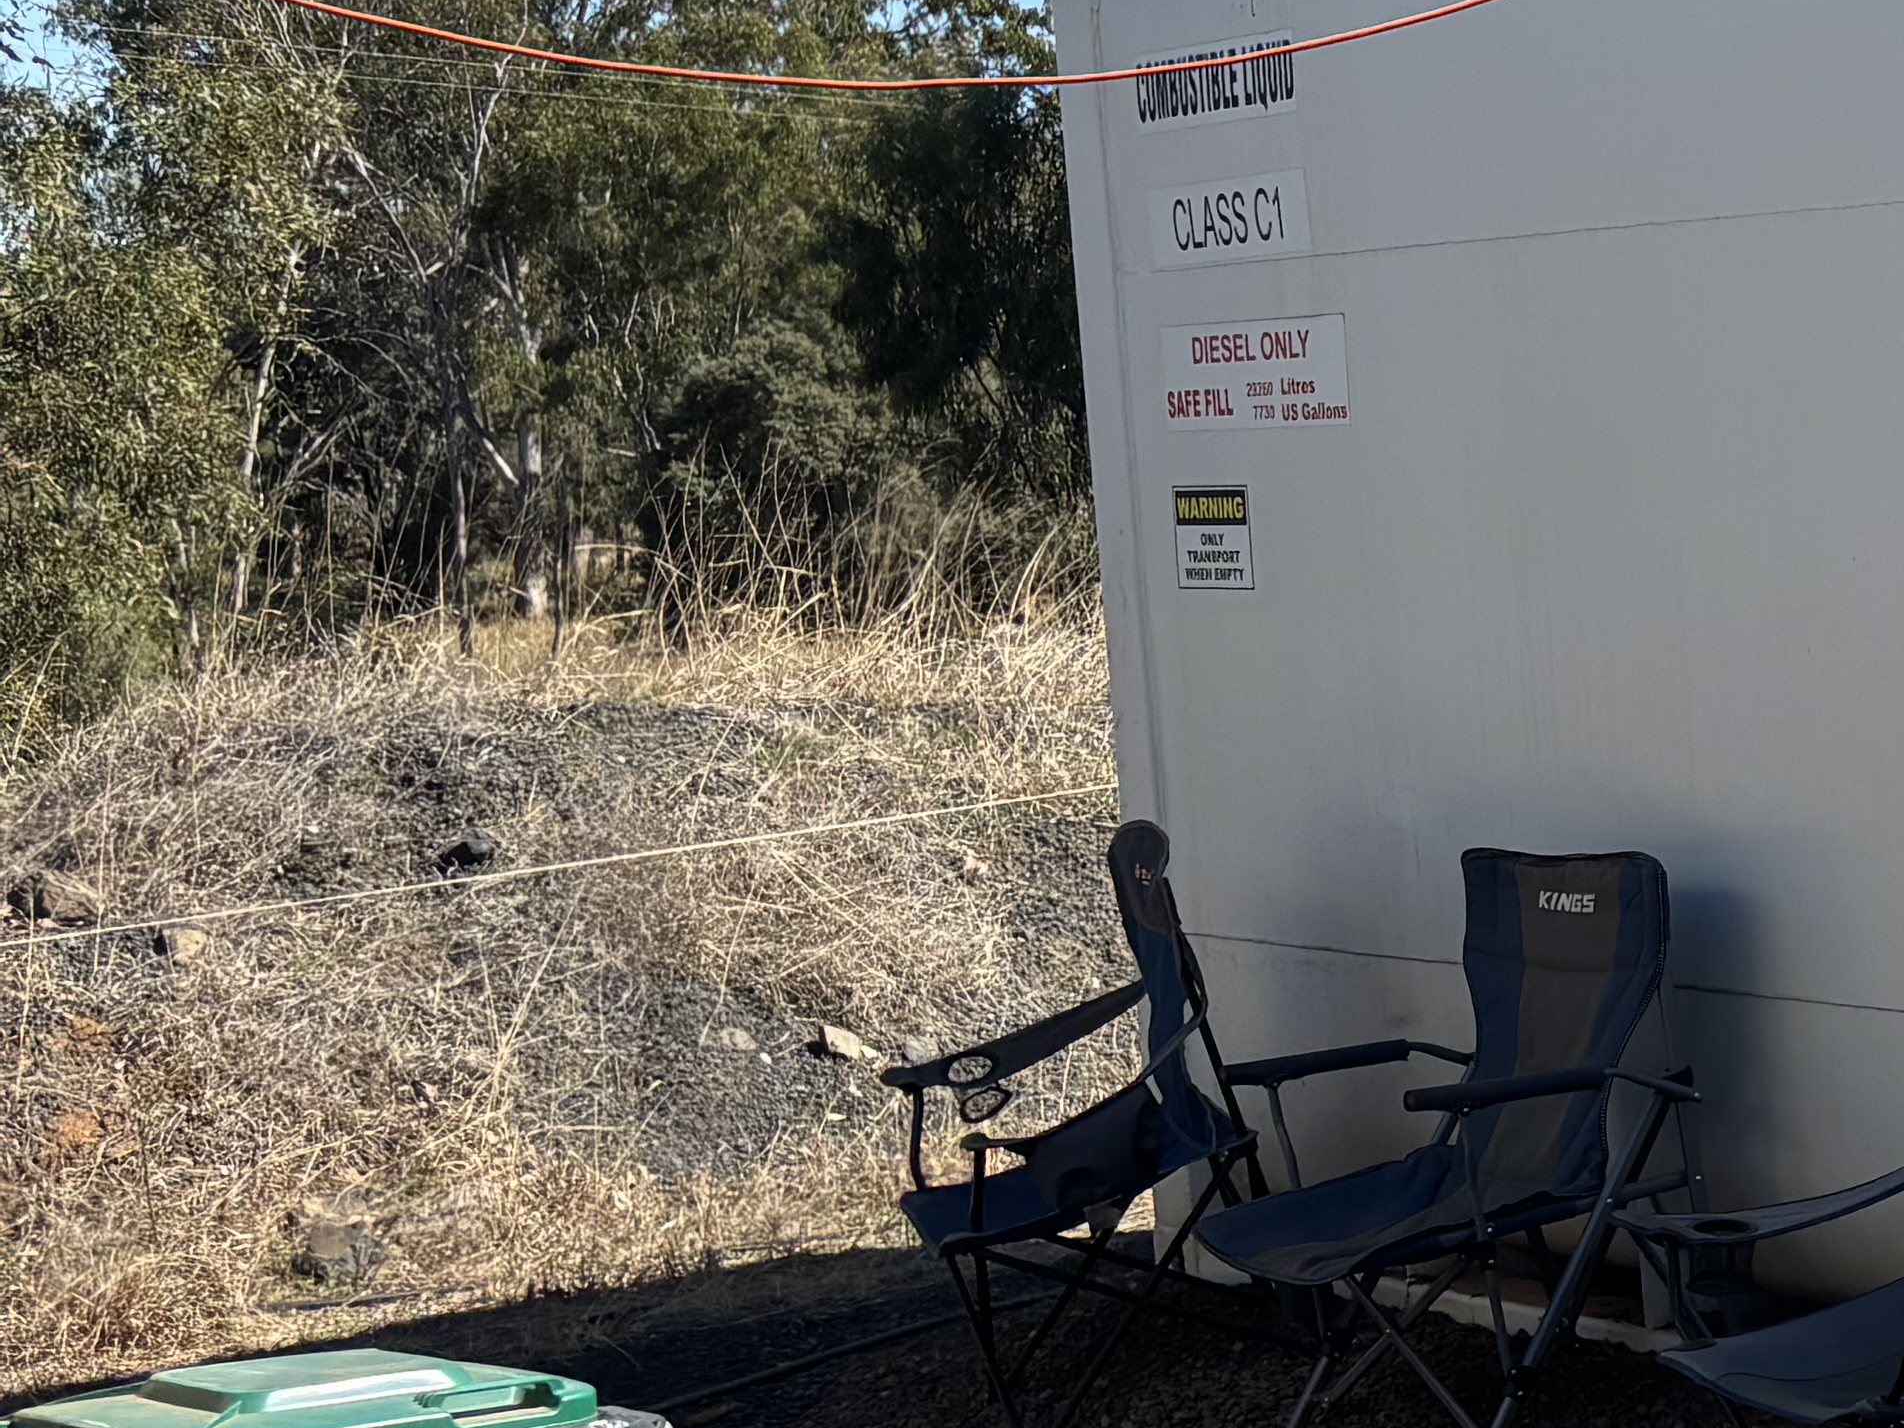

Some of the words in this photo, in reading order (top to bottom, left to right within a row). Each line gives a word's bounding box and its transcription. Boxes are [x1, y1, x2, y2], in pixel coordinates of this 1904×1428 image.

[1136, 49, 1239, 123] COMBUSTIBLE
[1242, 39, 1295, 111] LIQUID
[1173, 191, 1249, 251] CLASS
[1254, 186, 1286, 241] C1
[1191, 334, 1257, 364] DIESEL
[1260, 329, 1310, 360] ONLY
[1280, 377, 1316, 396] Litres
[1167, 389, 1202, 418] SAFE
[1205, 388, 1234, 417] FILL
[1281, 403, 1299, 421] US
[1302, 402, 1348, 420] Gallons
[1177, 496, 1245, 519] WARNING
[1200, 533, 1225, 546] ONLY
[1538, 890, 1596, 913] KINGS
